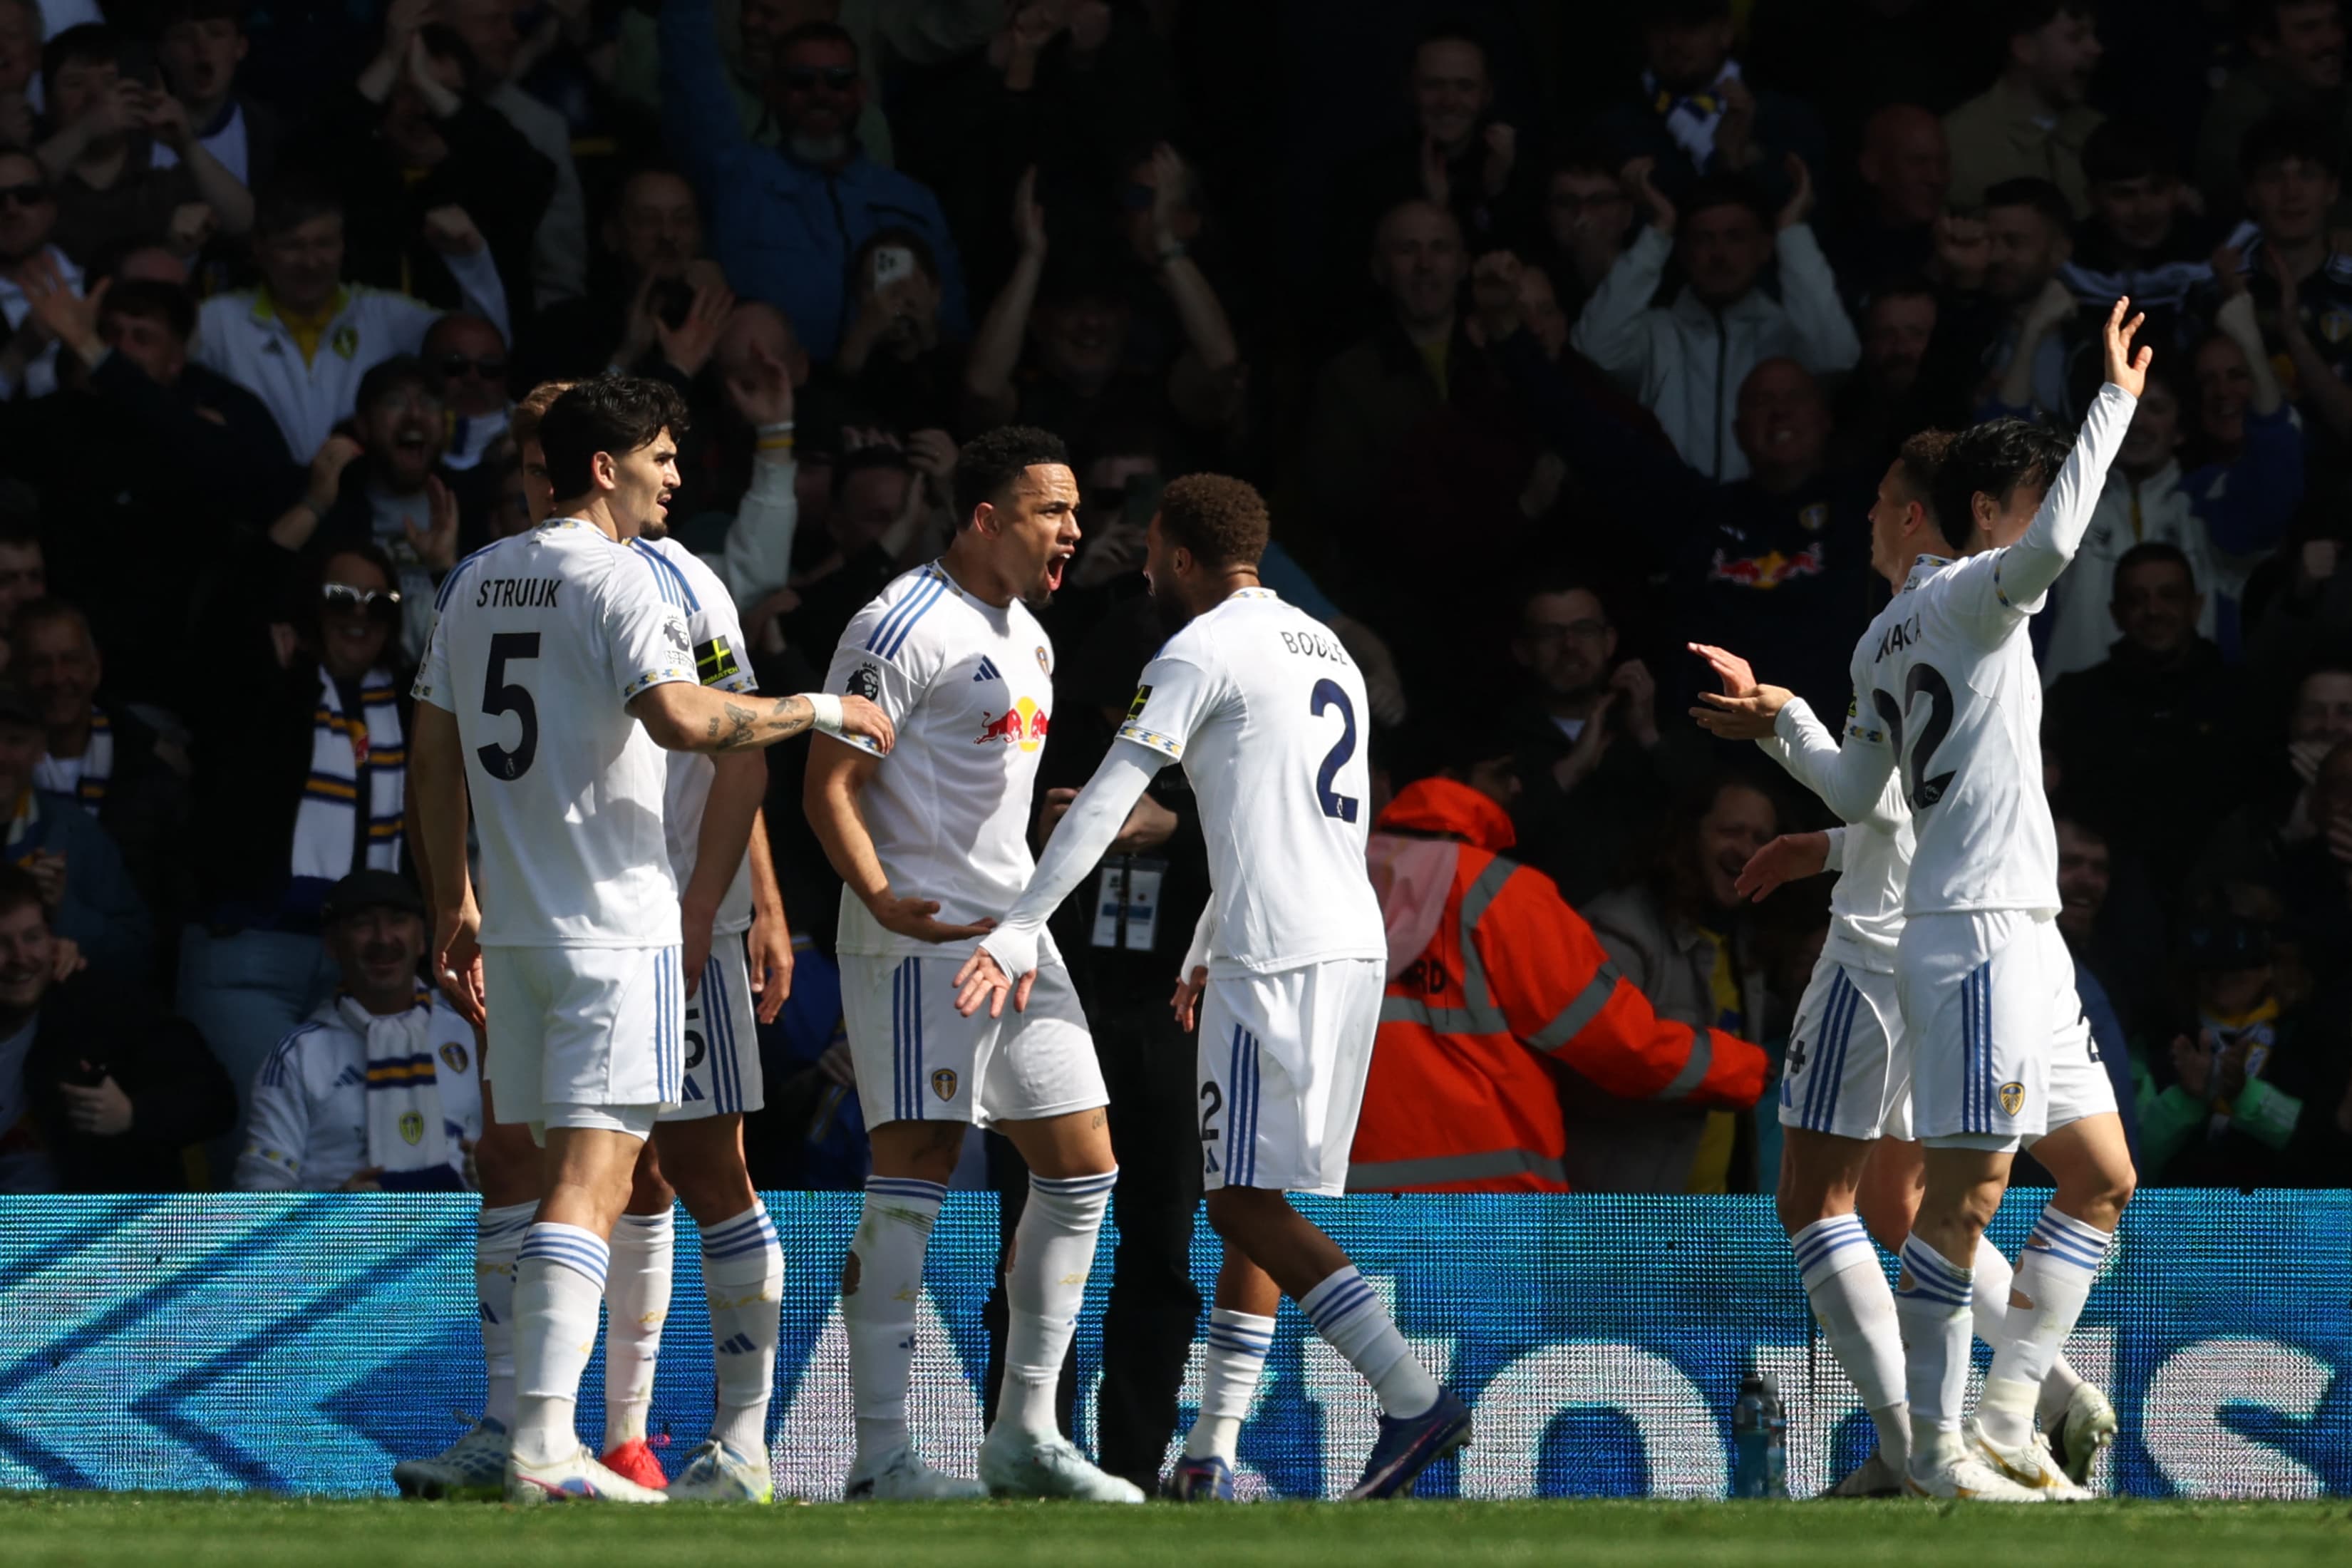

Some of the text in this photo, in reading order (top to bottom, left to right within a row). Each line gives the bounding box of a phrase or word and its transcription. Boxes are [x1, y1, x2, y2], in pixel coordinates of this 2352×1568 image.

[477, 578, 562, 609] STRUIJK
[701, 666, 738, 685] RIMATCH
[477, 632, 541, 781] 5
[1310, 678, 1359, 825] 2
[1200, 1080, 1222, 1140] 2
